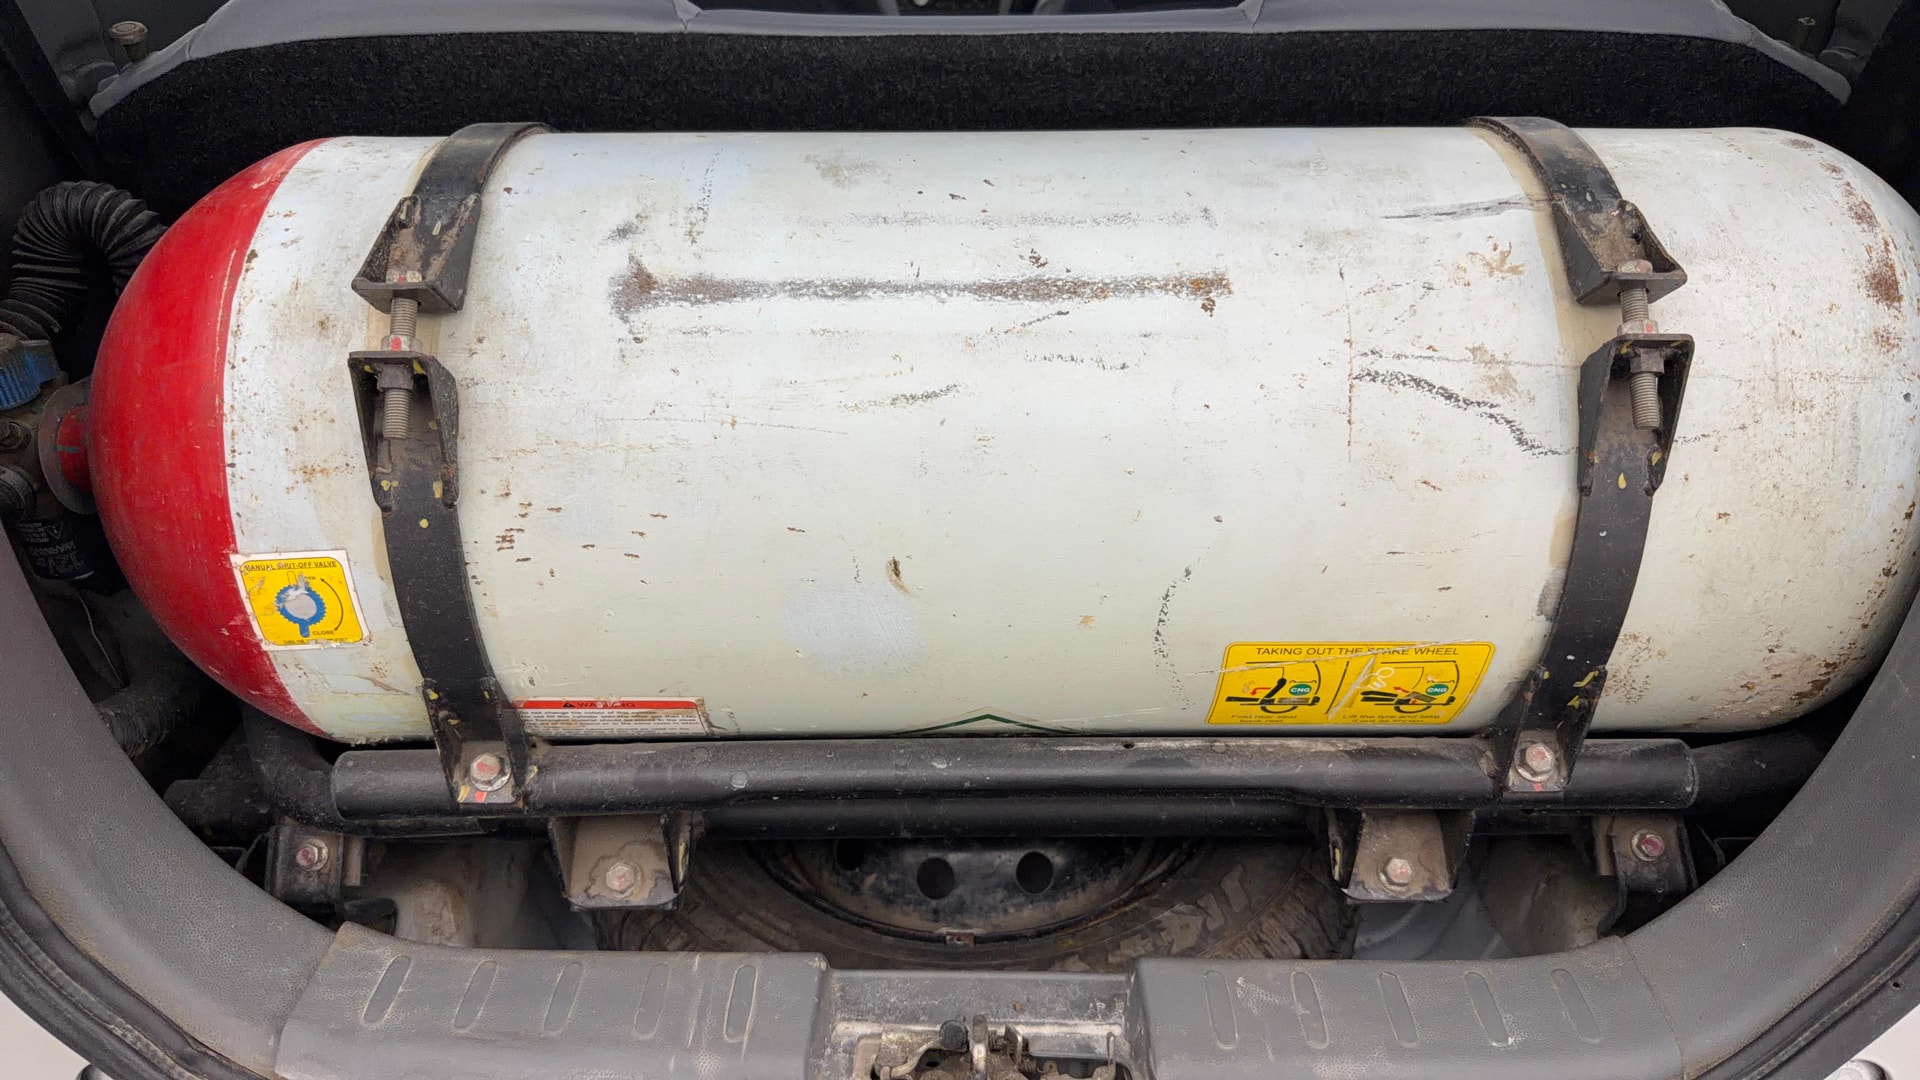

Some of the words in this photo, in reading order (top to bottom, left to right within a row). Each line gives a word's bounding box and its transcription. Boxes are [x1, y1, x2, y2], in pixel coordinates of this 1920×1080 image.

[244, 563, 276, 571] MANUAL
[277, 561, 312, 570] SHUT-OFF
[314, 560, 337, 568] VALVE
[1256, 647, 1303, 656] TAKING
[1306, 647, 1334, 656] OUT
[1338, 647, 1364, 656] THE
[1414, 647, 1460, 656] WHEEL
